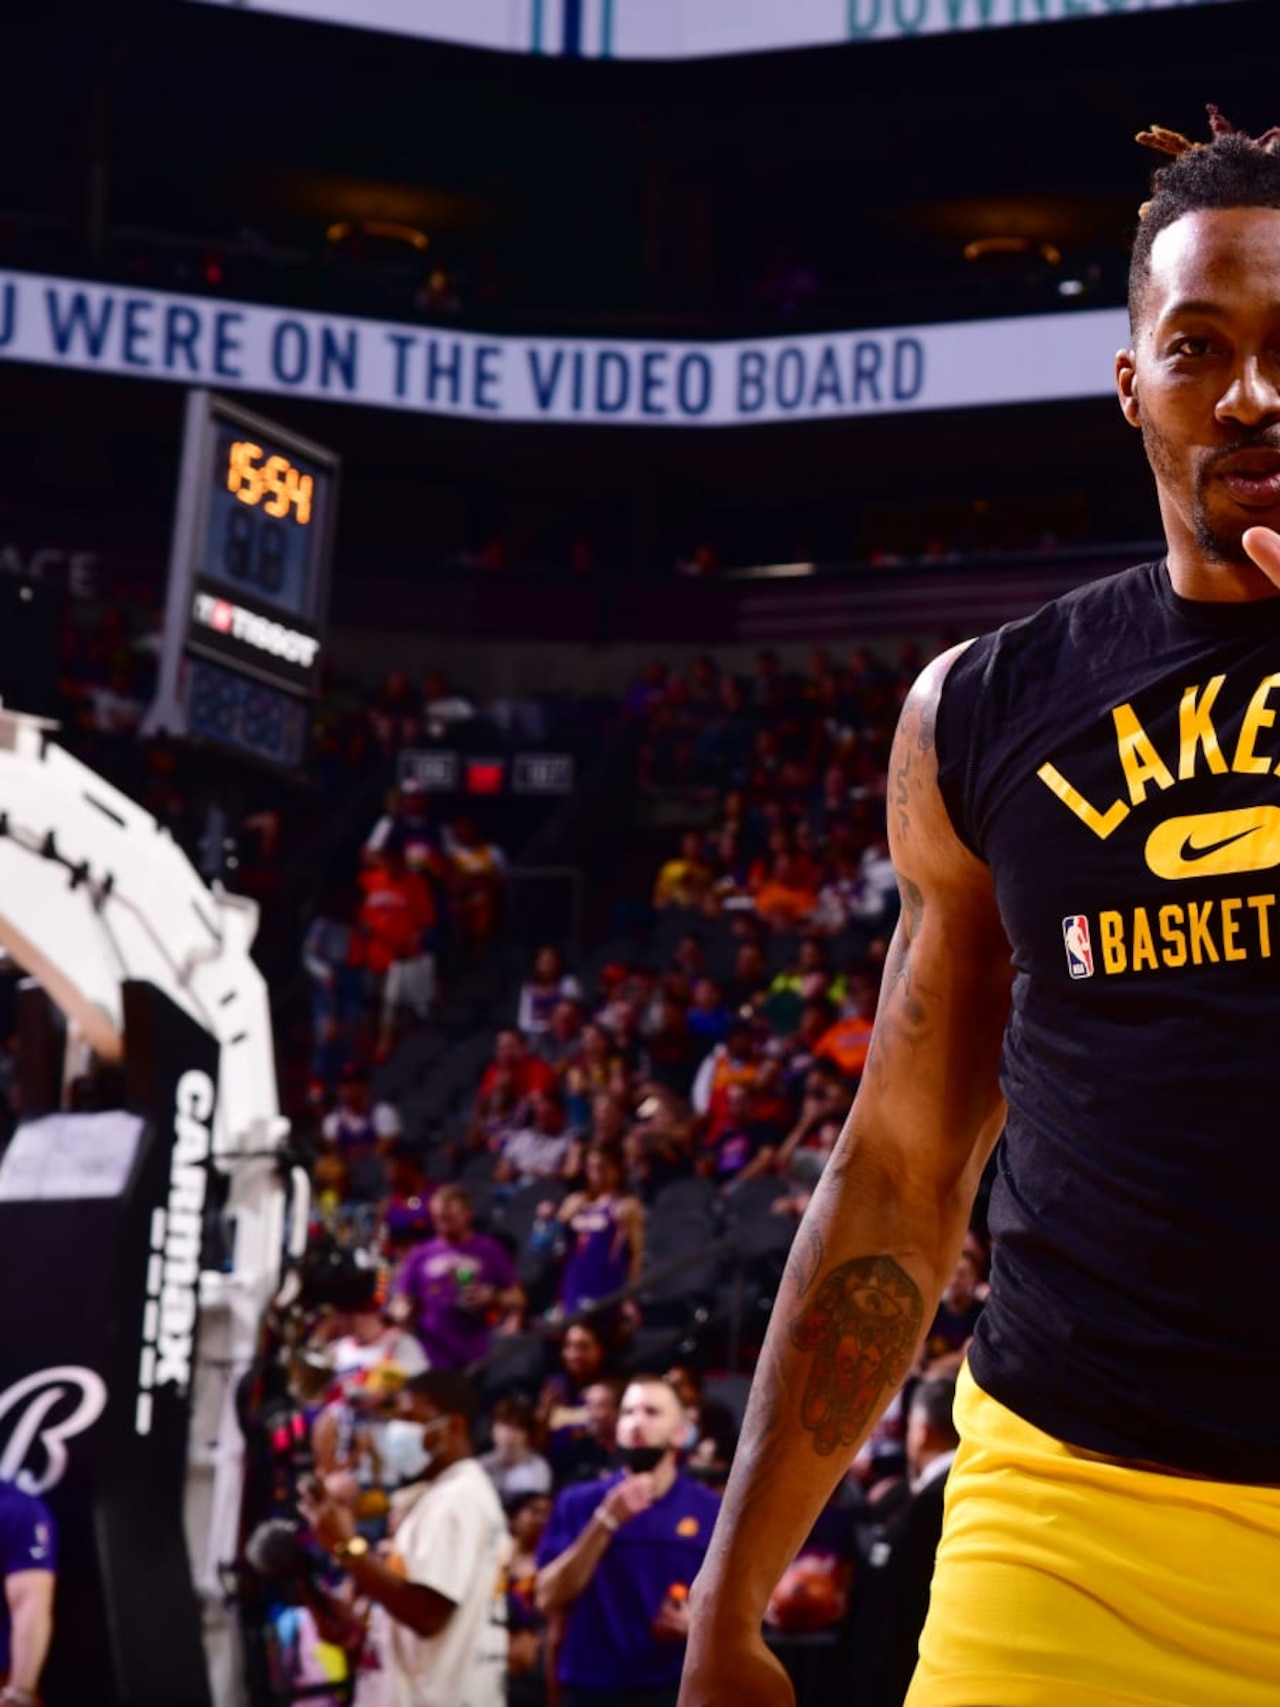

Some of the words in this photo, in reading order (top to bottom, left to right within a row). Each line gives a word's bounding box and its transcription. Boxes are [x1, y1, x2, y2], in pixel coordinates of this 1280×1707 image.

[46, 287, 243, 379] WERE
[271, 318, 359, 392] ON
[387, 334, 502, 410] THE
[528, 348, 712, 416] VIDEO
[735, 337, 924, 413] BOARD
